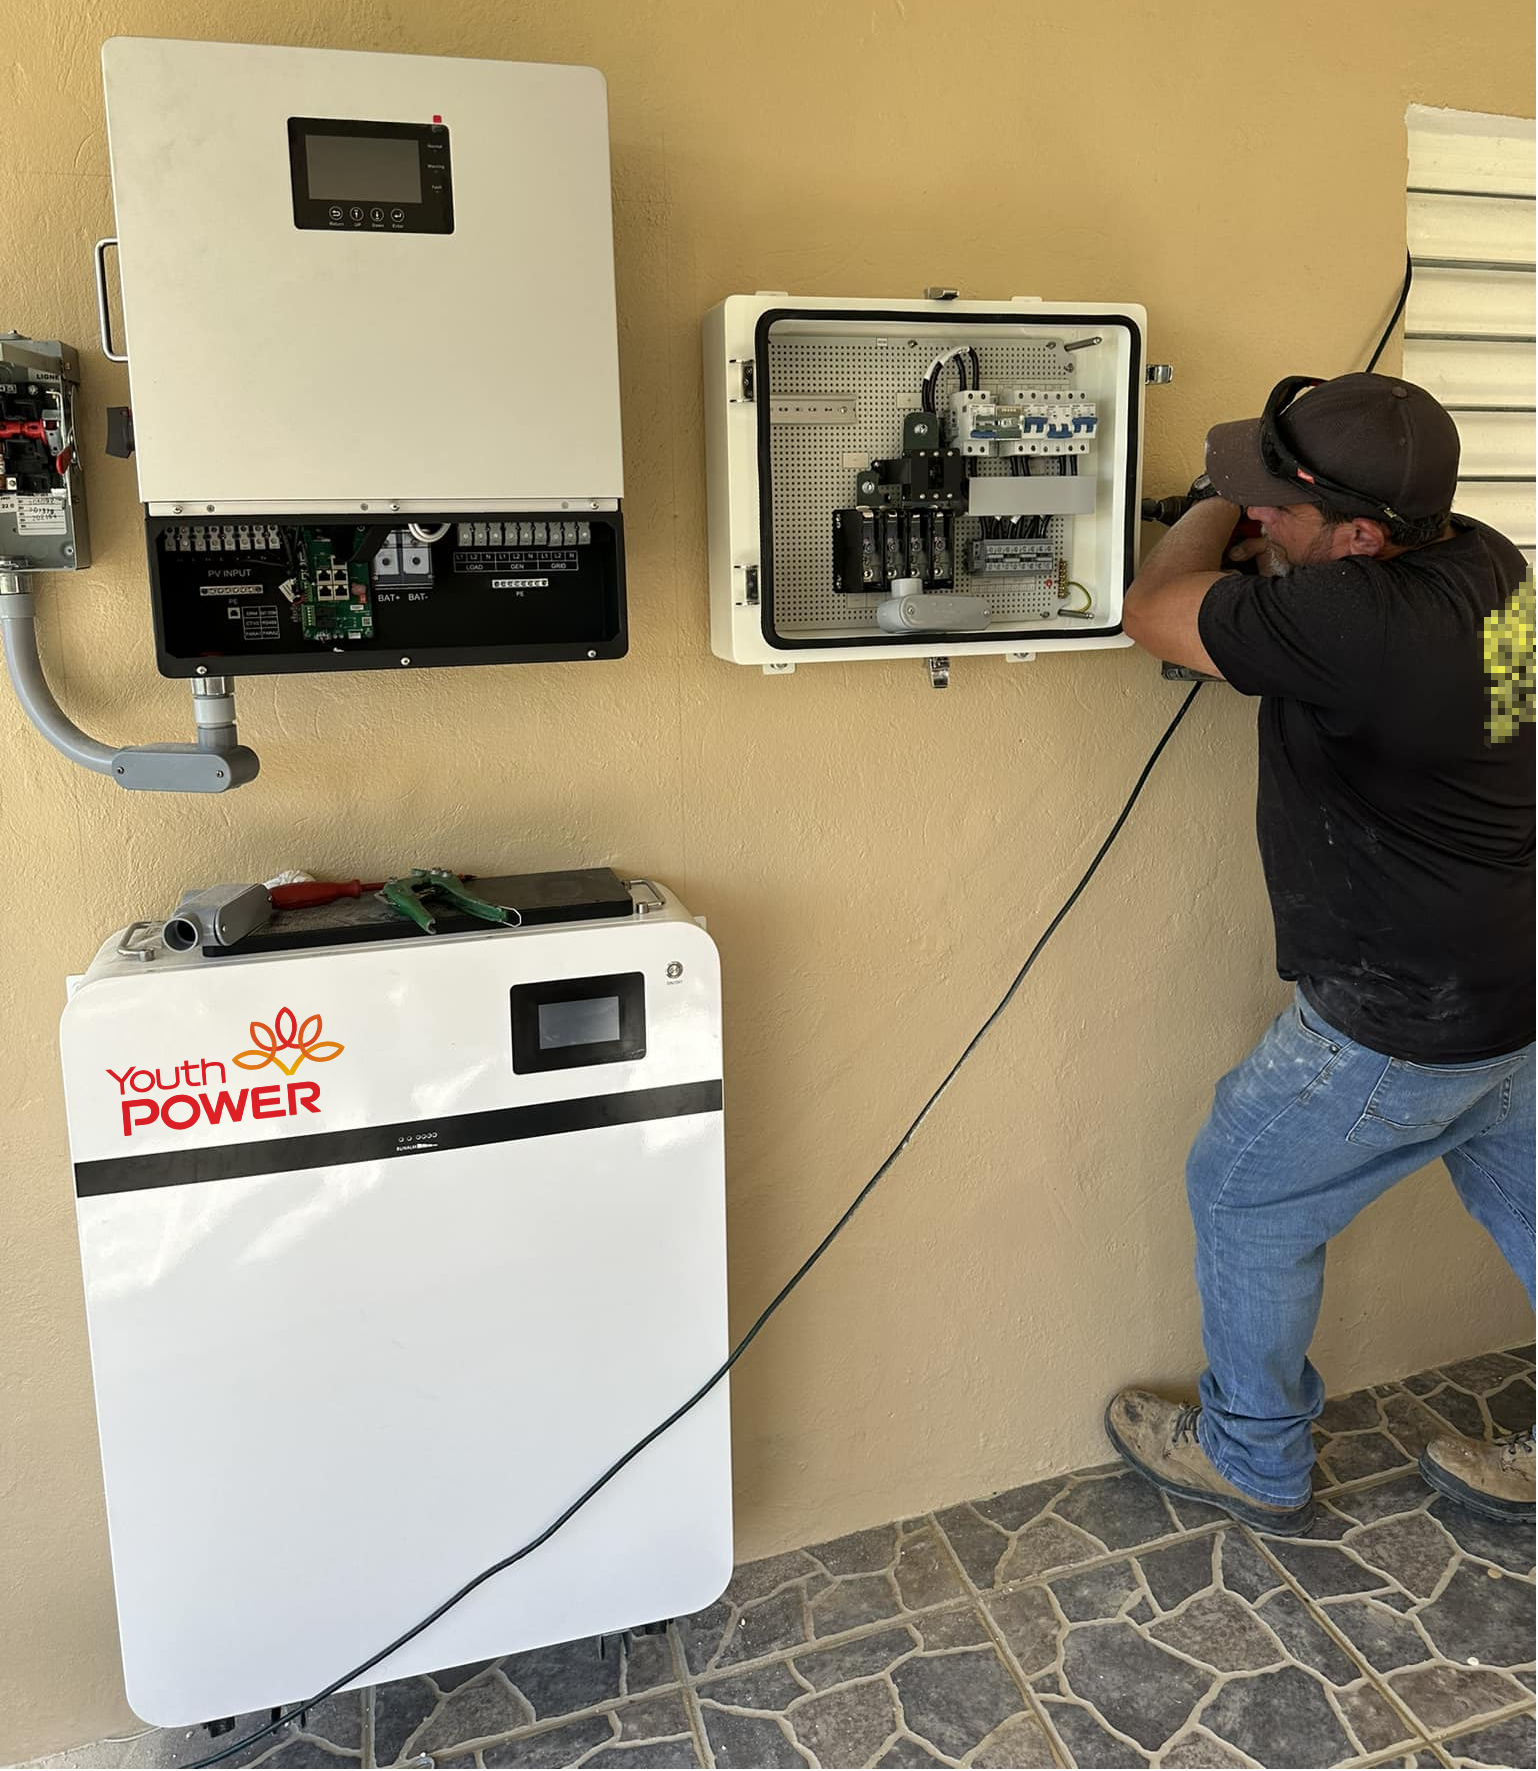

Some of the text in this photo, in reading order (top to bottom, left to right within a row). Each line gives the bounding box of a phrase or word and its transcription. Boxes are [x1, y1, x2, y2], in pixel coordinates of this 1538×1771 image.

[207, 568, 252, 578] PV INPUT
[105, 1058, 226, 1095] Youth
[121, 1081, 321, 1136] POWER
